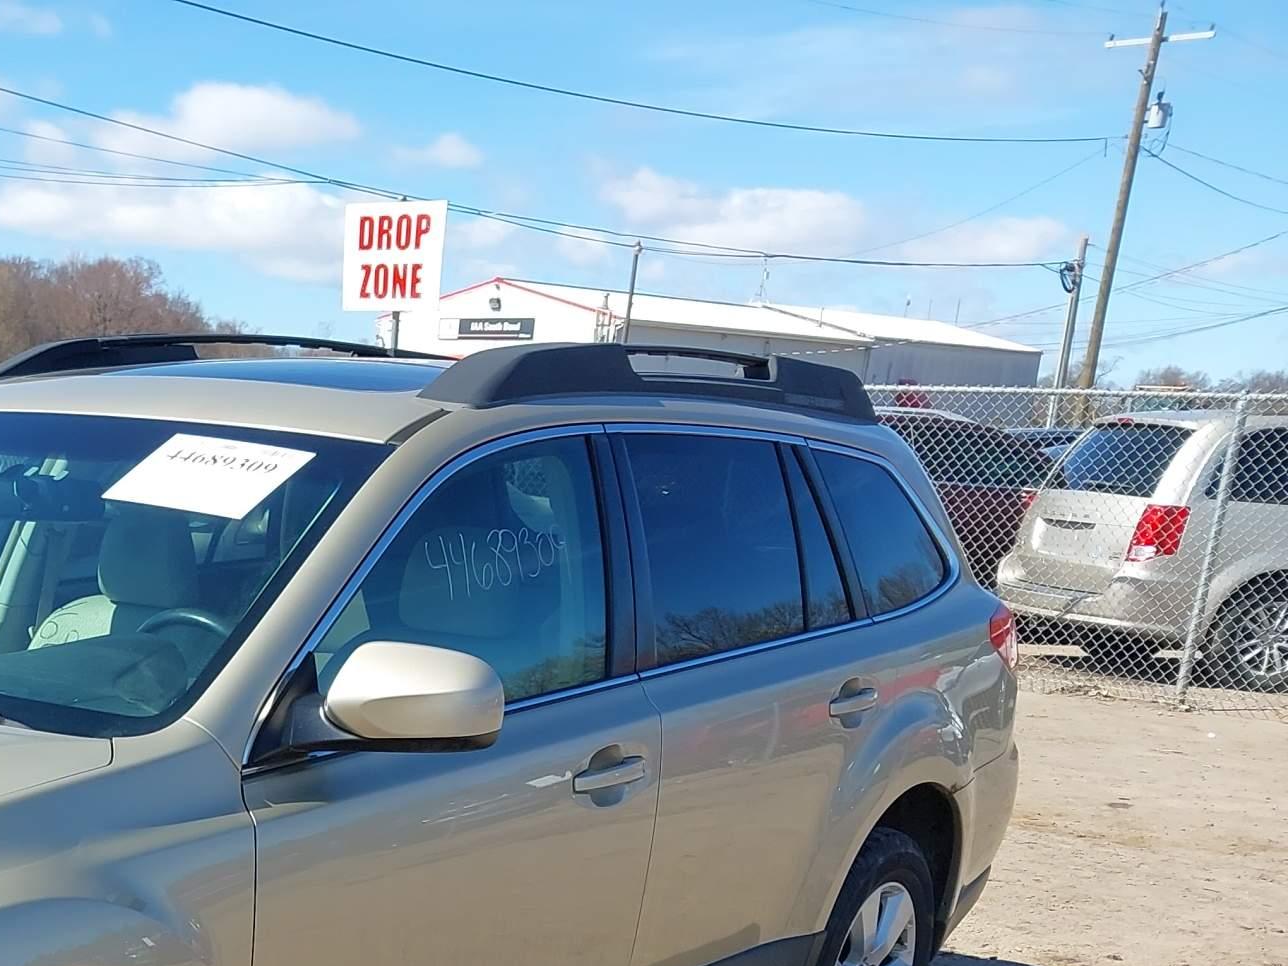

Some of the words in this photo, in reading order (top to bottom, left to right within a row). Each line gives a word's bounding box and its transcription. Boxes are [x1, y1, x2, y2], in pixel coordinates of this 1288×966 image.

[358, 213, 431, 250] DROP
[359, 263, 422, 299] ZONE
[166, 449, 279, 474] 44689309
